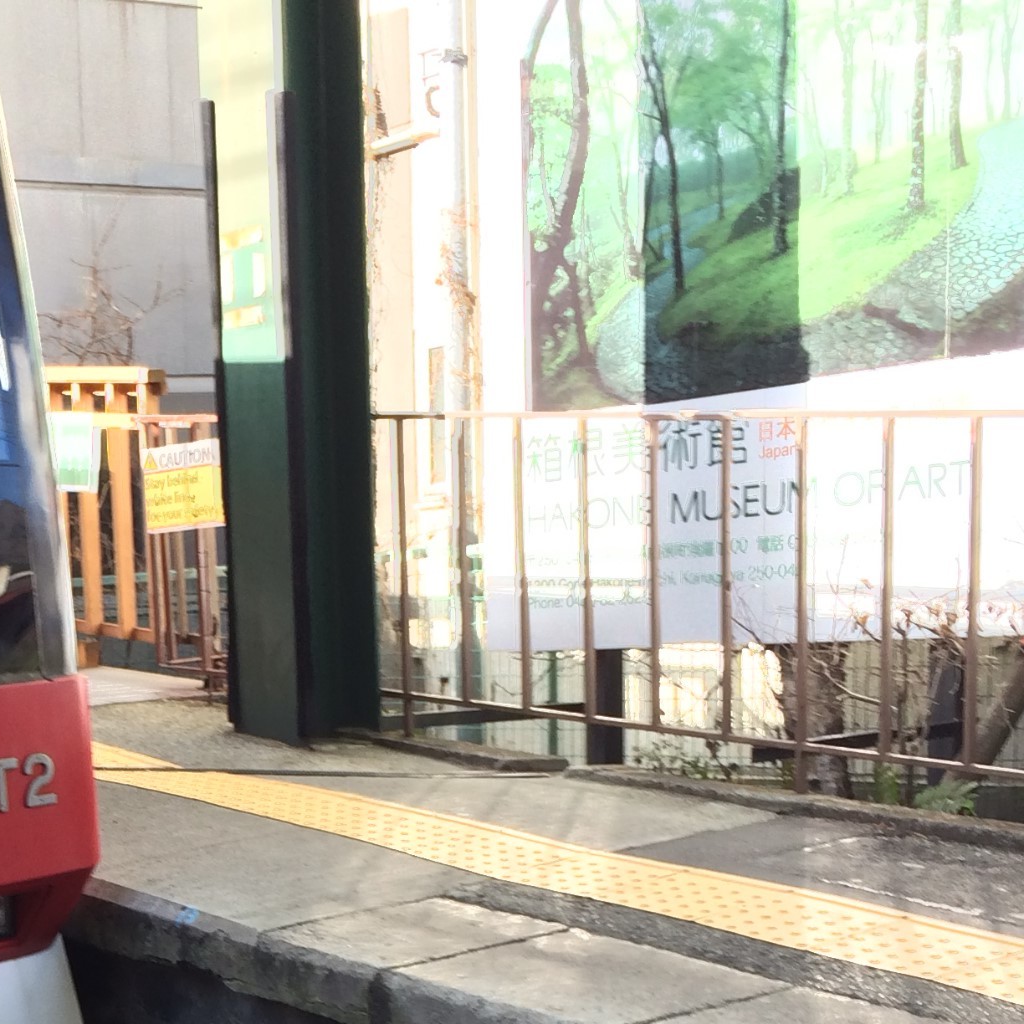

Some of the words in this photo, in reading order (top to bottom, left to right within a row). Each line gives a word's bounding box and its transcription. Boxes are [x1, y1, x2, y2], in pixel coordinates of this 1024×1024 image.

[526, 419, 749, 483] 箱根美術館
[527, 492, 650, 534] HAKONE
[670, 476, 818, 525] MUSEUM
[833, 469, 887, 507] OF
[897, 460, 972, 501] ART
